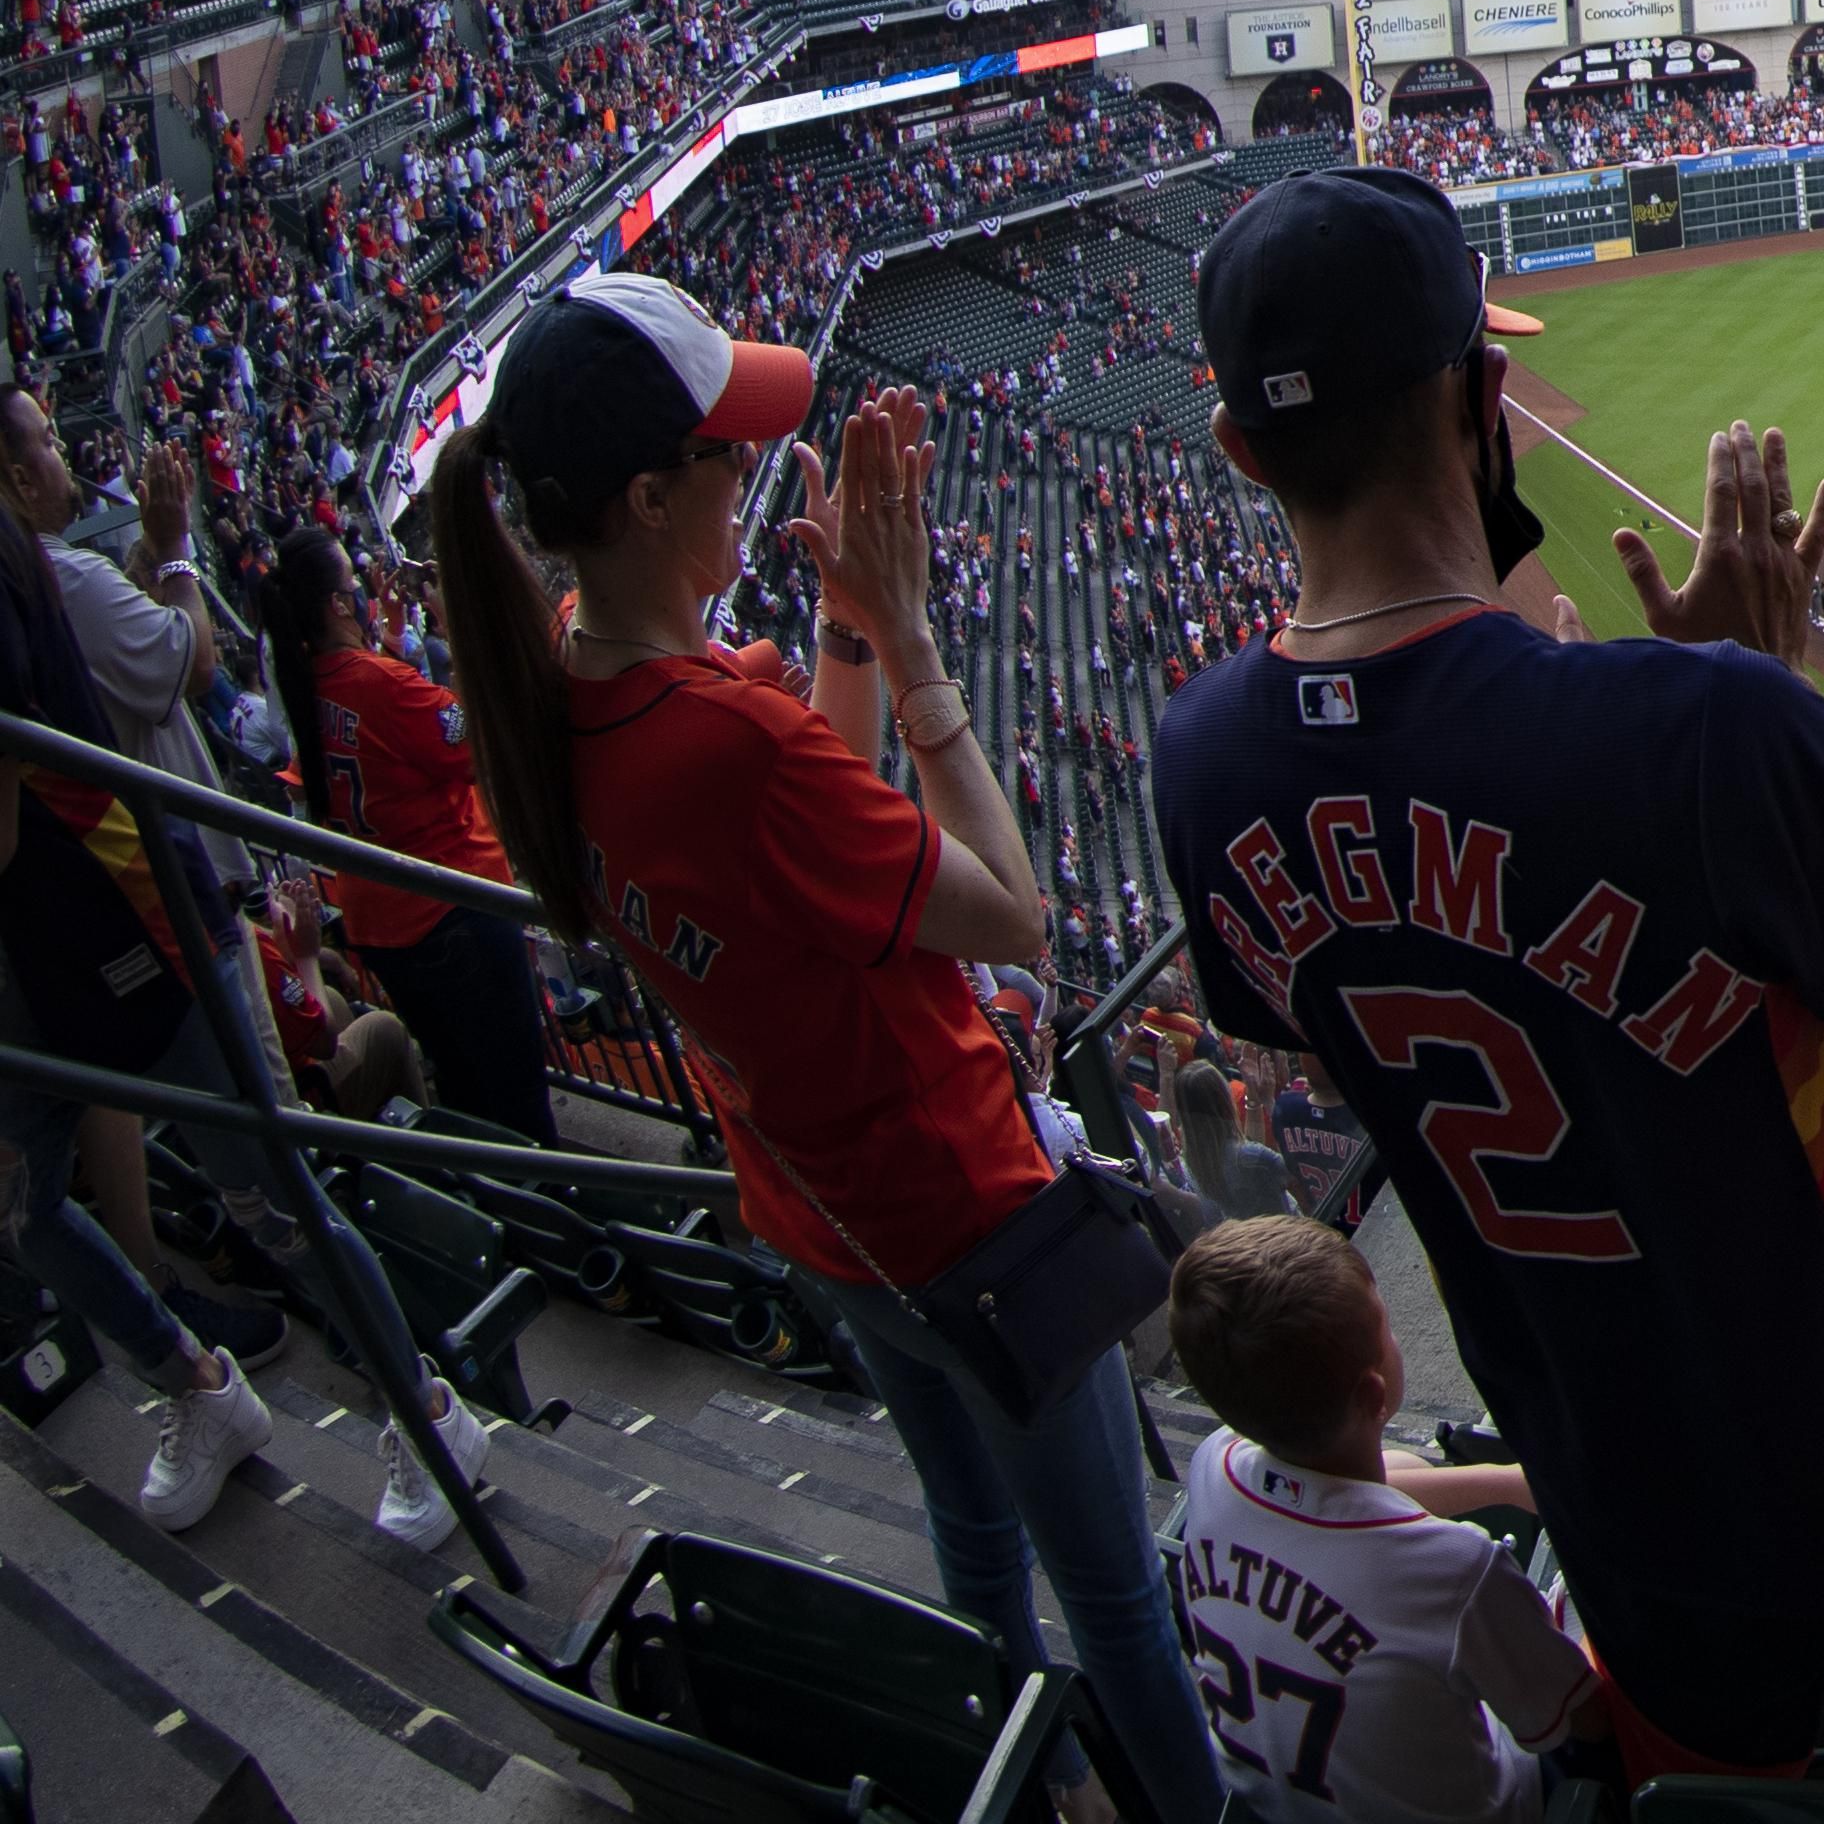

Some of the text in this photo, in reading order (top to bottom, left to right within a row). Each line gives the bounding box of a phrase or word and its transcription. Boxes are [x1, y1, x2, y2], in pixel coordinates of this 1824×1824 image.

[1248, 19, 1311, 33] FOUNDATION
[1474, 2, 1558, 22] CHENIERE
[1584, 3, 1675, 22] ConocoPhillips
[1355, 15, 1376, 105] FAIR
[1338, 986, 1642, 1261] 2
[35, 1351, 53, 1379] 3
[1183, 1537, 1379, 1676] ALTUVE
[1189, 1612, 1346, 1805] 27
